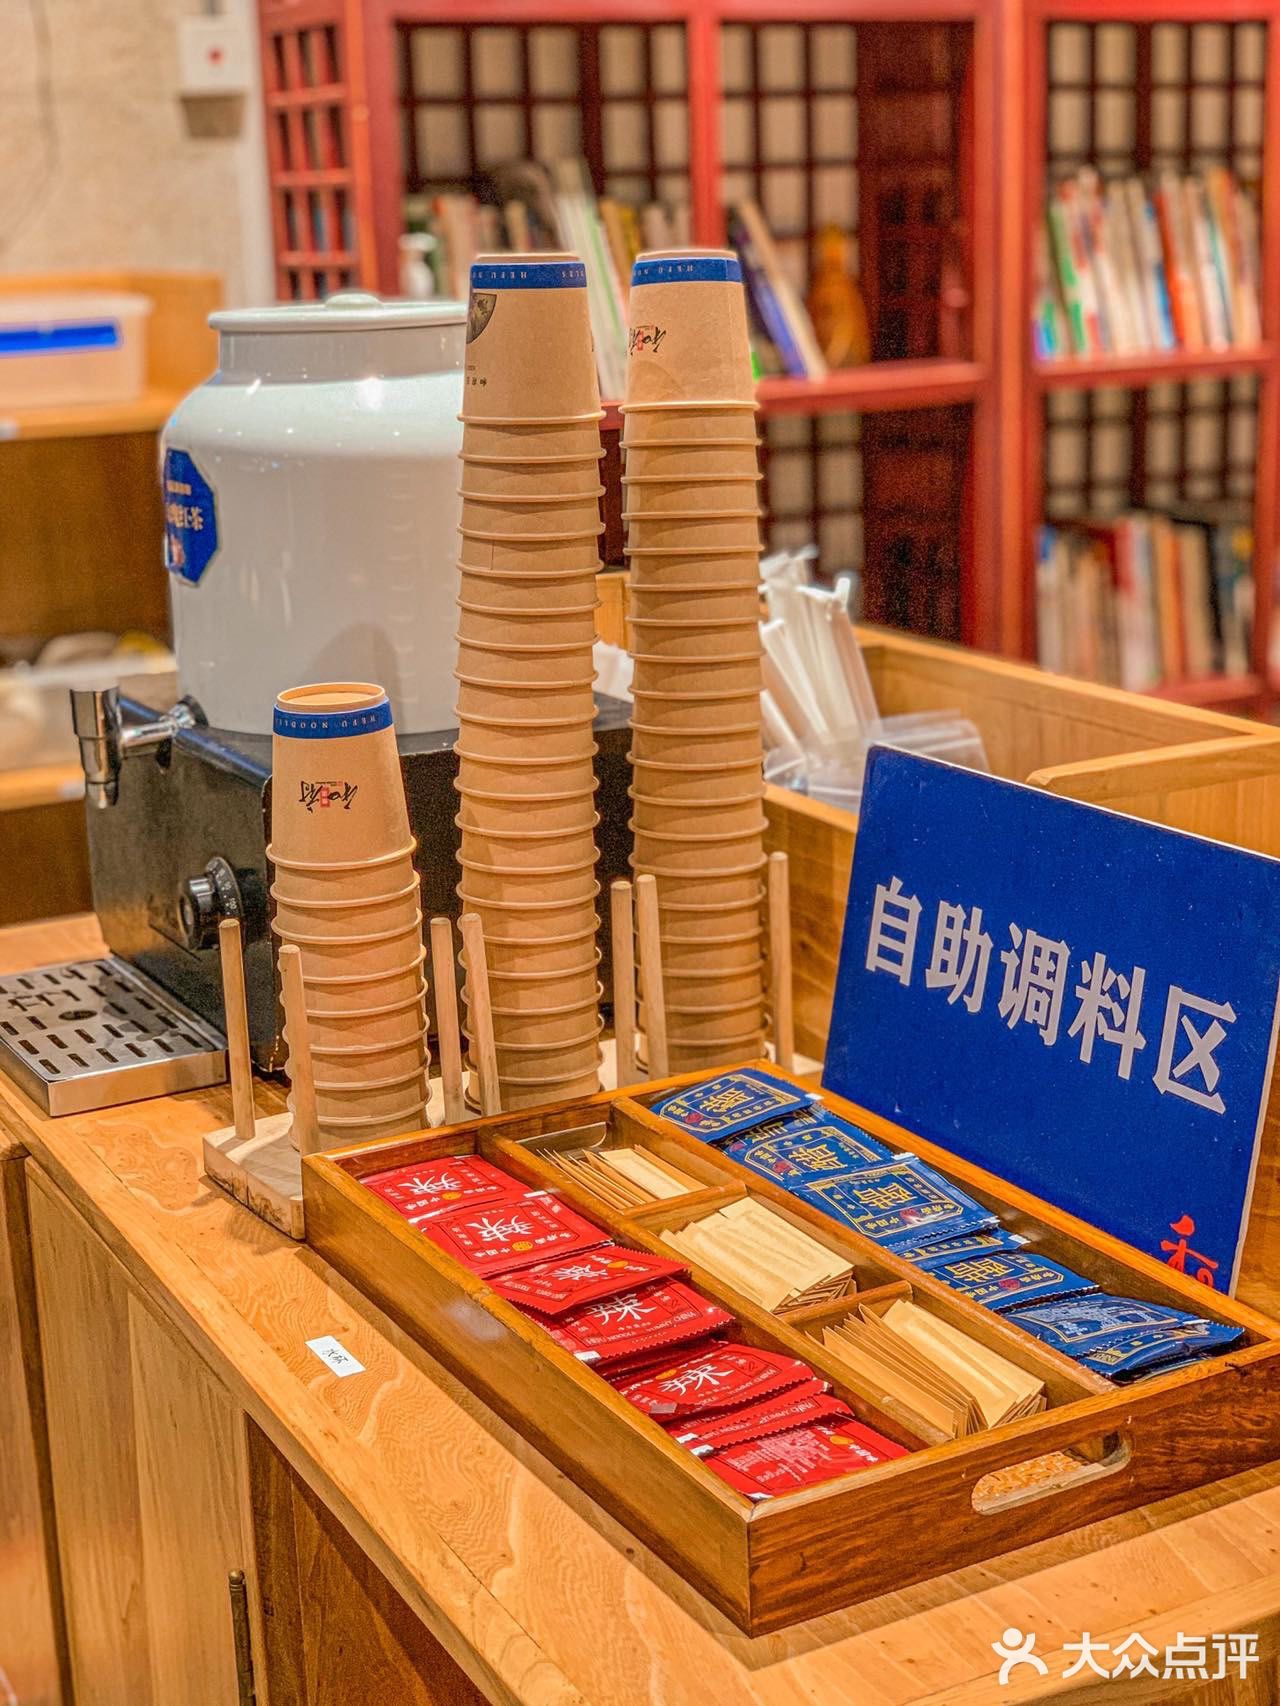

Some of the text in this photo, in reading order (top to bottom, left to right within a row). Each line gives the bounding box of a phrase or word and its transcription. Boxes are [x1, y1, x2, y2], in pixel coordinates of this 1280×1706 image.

[865, 875, 1238, 1115] 自助调料区
[852, 1182, 918, 1210] 醋
[465, 1214, 535, 1243] 辣
[583, 1292, 658, 1326] 辣
[657, 1362, 735, 1396] 辣
